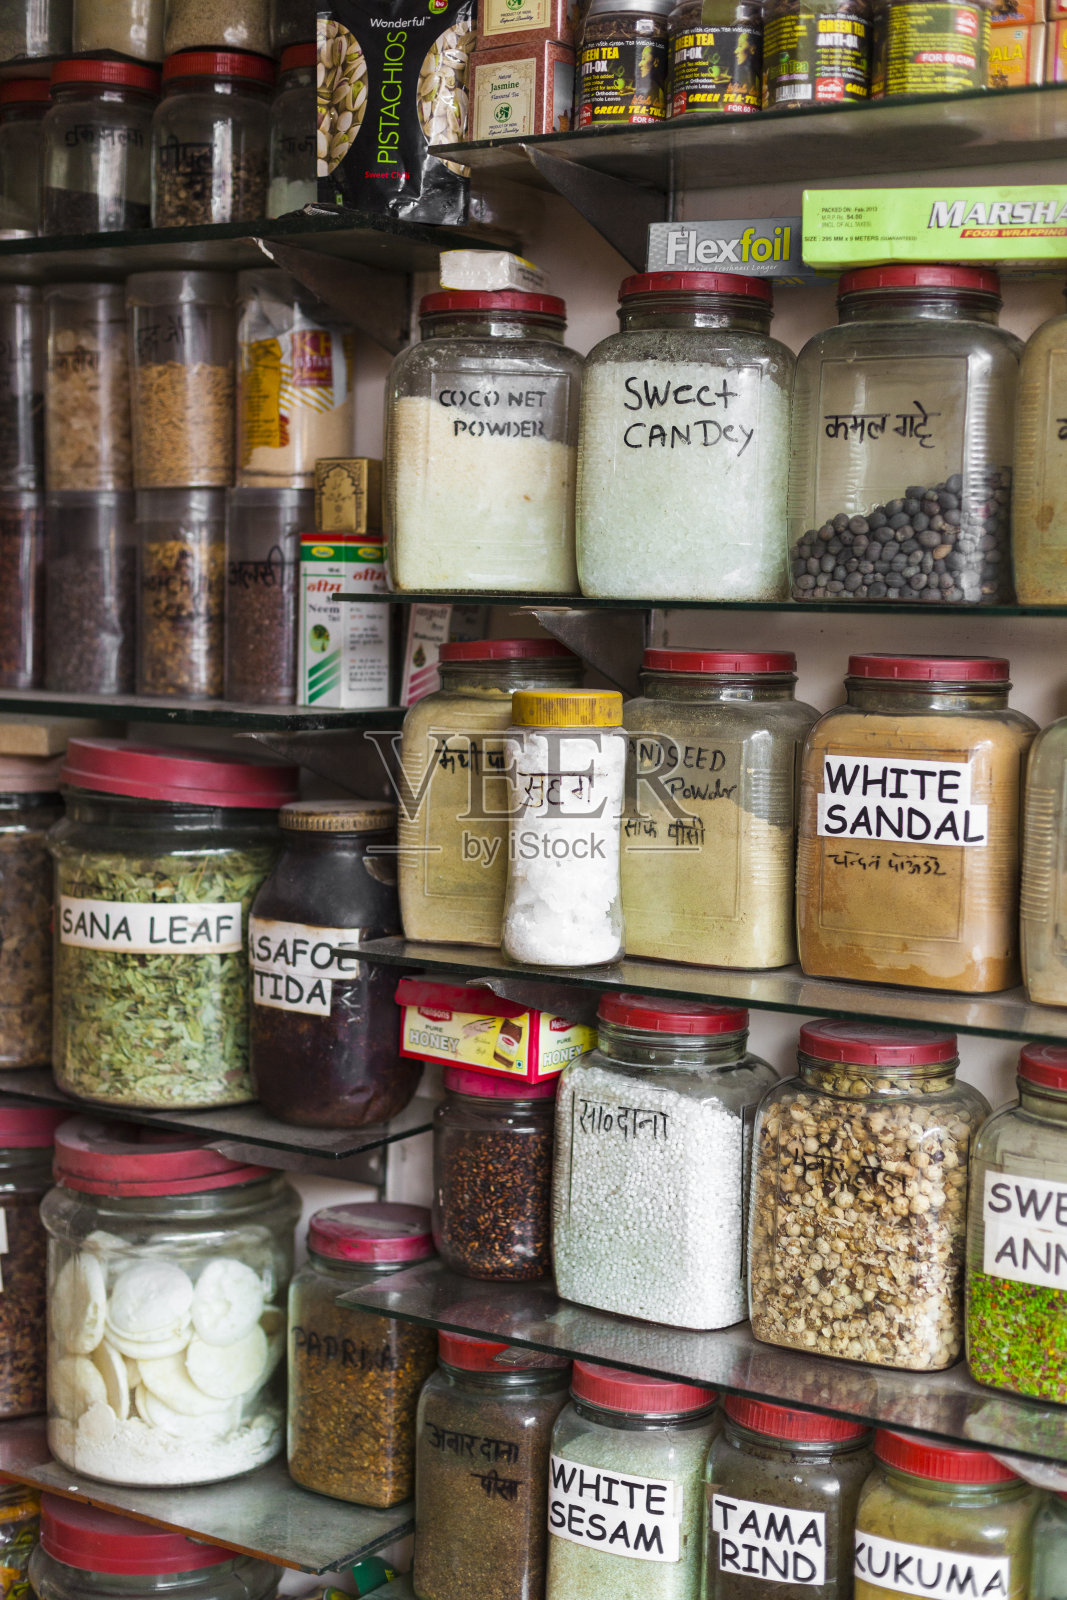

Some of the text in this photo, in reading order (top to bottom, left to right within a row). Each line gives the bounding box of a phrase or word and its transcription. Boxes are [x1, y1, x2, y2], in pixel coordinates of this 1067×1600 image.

[696, 34, 714, 46] TEA
[601, 47, 620, 60] TEA
[921, 53, 943, 62] FOR
[377, 31, 408, 164] PISTACHIOS
[489, 80, 520, 94] Jasmine
[688, 93, 720, 103] GREEN
[594, 105, 626, 115] GREEN
[364, 170, 389, 180] Sweet
[1001, 228, 1067, 237] WRAPPING
[666, 226, 791, 265] Flexfoil
[306, 579, 343, 592] नीम
[825, 761, 962, 804] WHITE
[824, 804, 985, 844] SANDAL
[62, 908, 234, 945] SANA LEAF
[254, 970, 326, 1006] TIDA
[408, 1028, 460, 1053] HONEY
[424, 1024, 444, 1033] PURE
[556, 1036, 572, 1046] PURE
[543, 1044, 584, 1068] HONEY
[551, 1459, 668, 1516] WHITE
[550, 1500, 664, 1555] SESAM
[714, 1499, 823, 1548] TAMA
[720, 1538, 818, 1584] RIND
